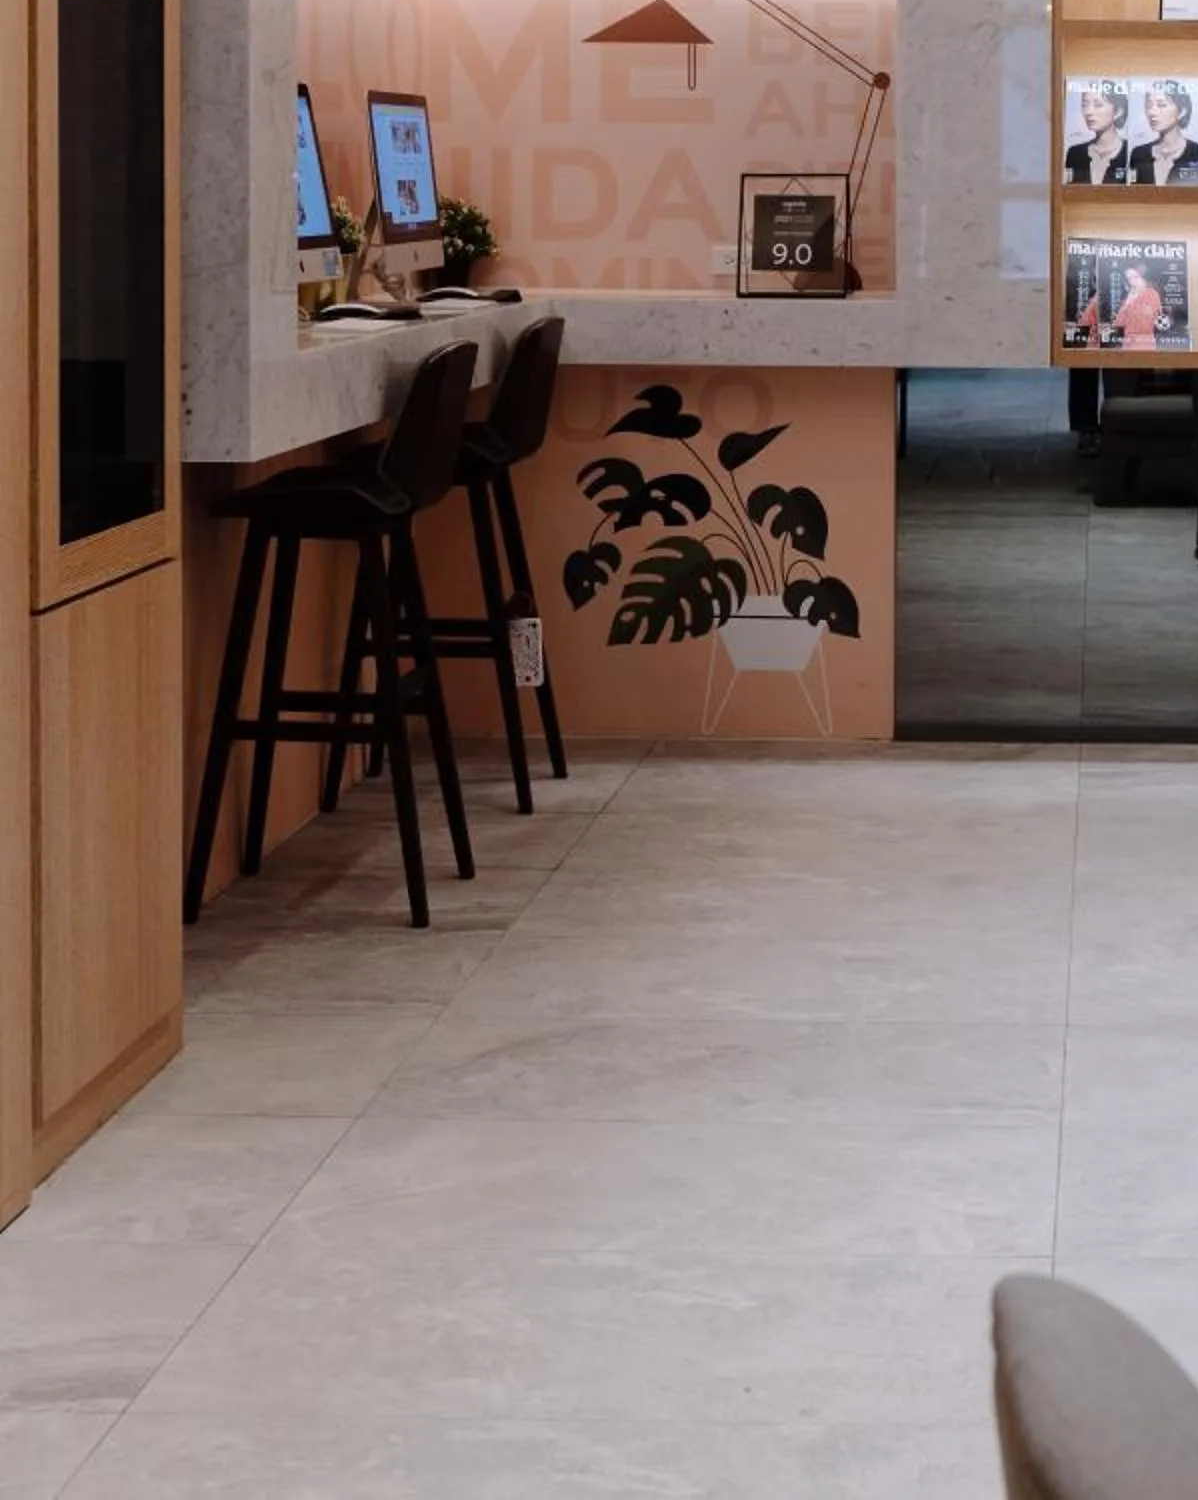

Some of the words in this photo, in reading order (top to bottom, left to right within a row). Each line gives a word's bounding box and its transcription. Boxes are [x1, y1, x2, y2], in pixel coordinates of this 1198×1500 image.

[772, 243, 812, 265] 9.0
[1098, 243, 1142, 259] marie
[1144, 243, 1185, 260] claire
